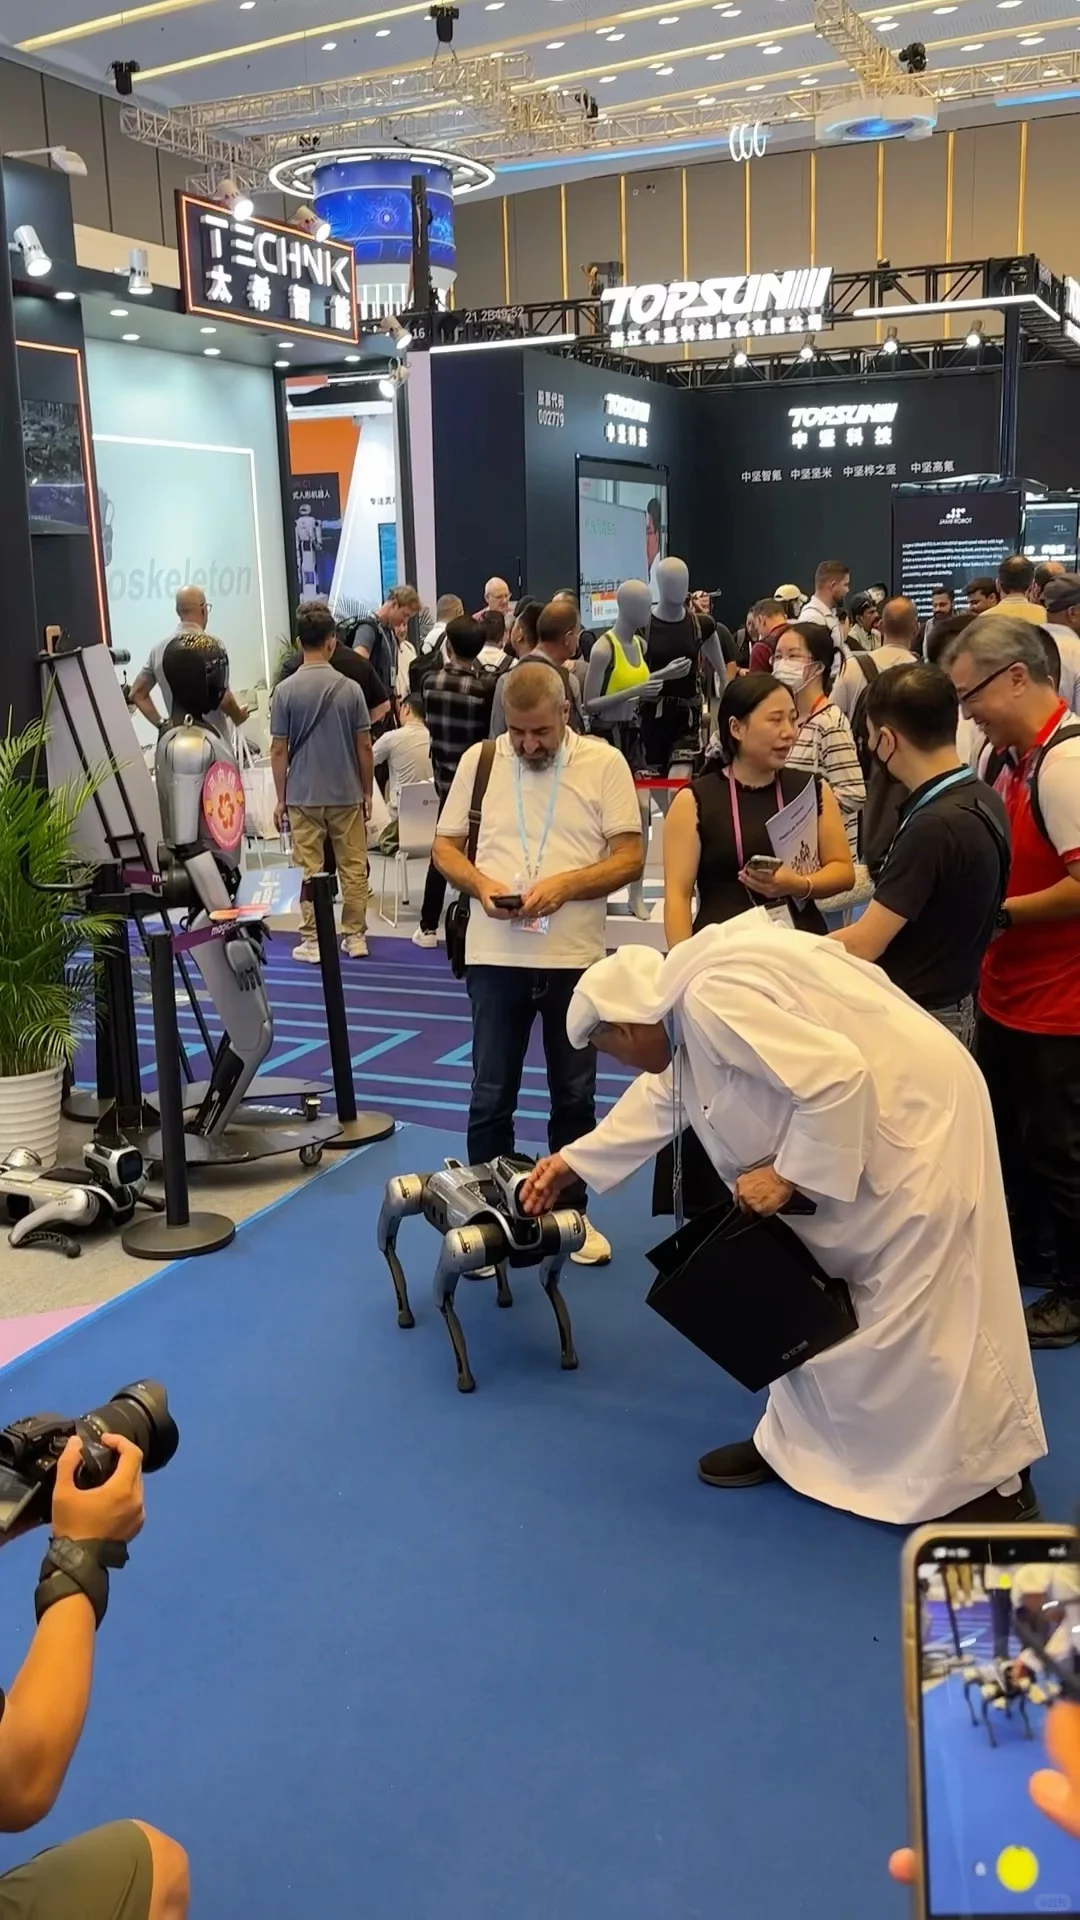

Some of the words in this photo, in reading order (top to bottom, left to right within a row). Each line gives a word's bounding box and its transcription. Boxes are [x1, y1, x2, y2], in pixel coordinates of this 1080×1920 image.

[205, 264, 351, 331] 太希智能
[600, 269, 797, 326] TOPSUN
[791, 425, 892, 449] 中坚科技
